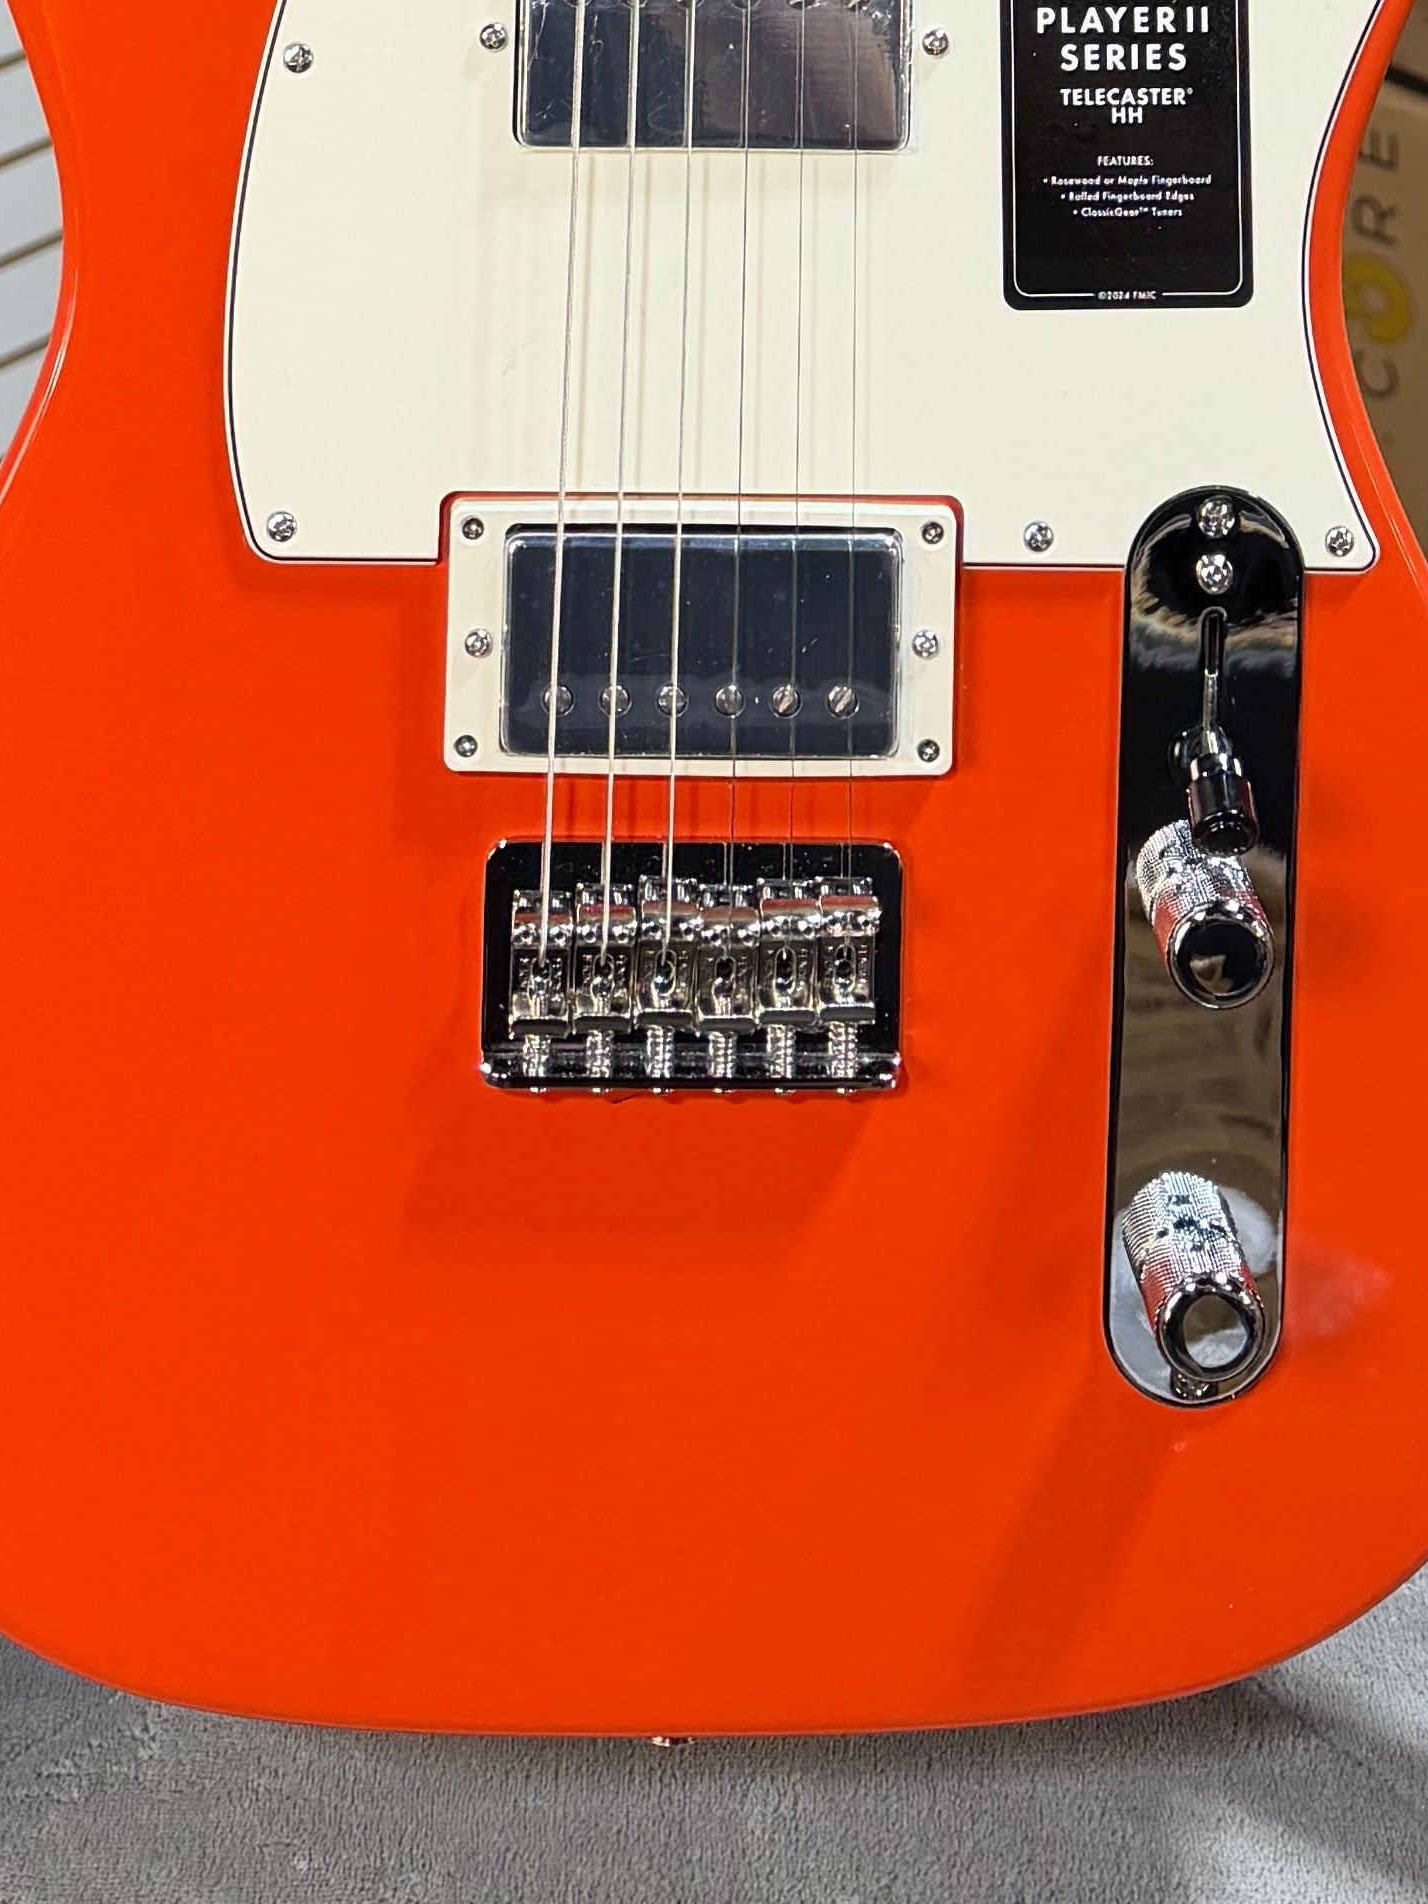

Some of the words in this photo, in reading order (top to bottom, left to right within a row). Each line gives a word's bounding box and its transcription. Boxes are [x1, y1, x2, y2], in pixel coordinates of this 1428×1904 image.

[1037, 5, 1177, 34] PLAYER
[1186, 5, 1210, 34] II
[1060, 43, 1188, 72] SERIES
[1111, 106, 1144, 125] HH
[1097, 155, 1154, 167] FEATURES:
[1104, 177, 1114, 186] or
[1152, 174, 1212, 188] Fingerboard
